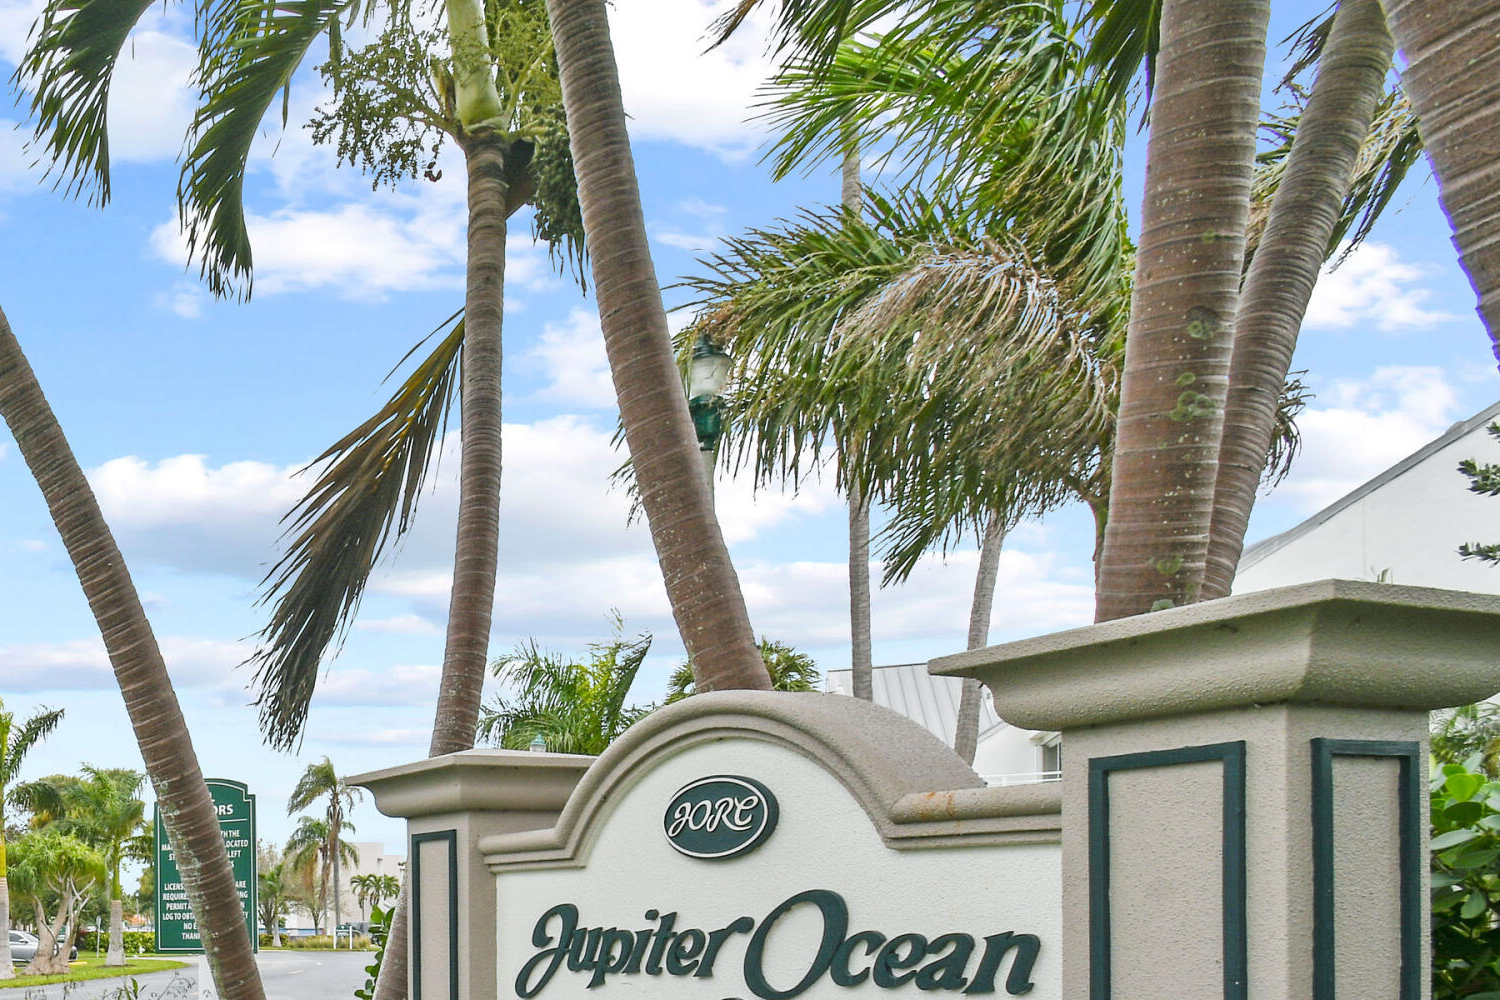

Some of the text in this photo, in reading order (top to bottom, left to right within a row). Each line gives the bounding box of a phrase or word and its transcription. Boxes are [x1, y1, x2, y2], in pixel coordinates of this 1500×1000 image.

[668, 795, 759, 837] JORC
[229, 829, 240, 837] THE
[227, 850, 241, 858] LEFT
[164, 882, 185, 891] LICENS
[162, 892, 188, 901] REQUIRE
[166, 902, 188, 910] PERMIT
[162, 911, 196, 921] LOG TO OBTA
[183, 922, 192, 930] NO
[514, 902, 755, 1000] Jupiter
